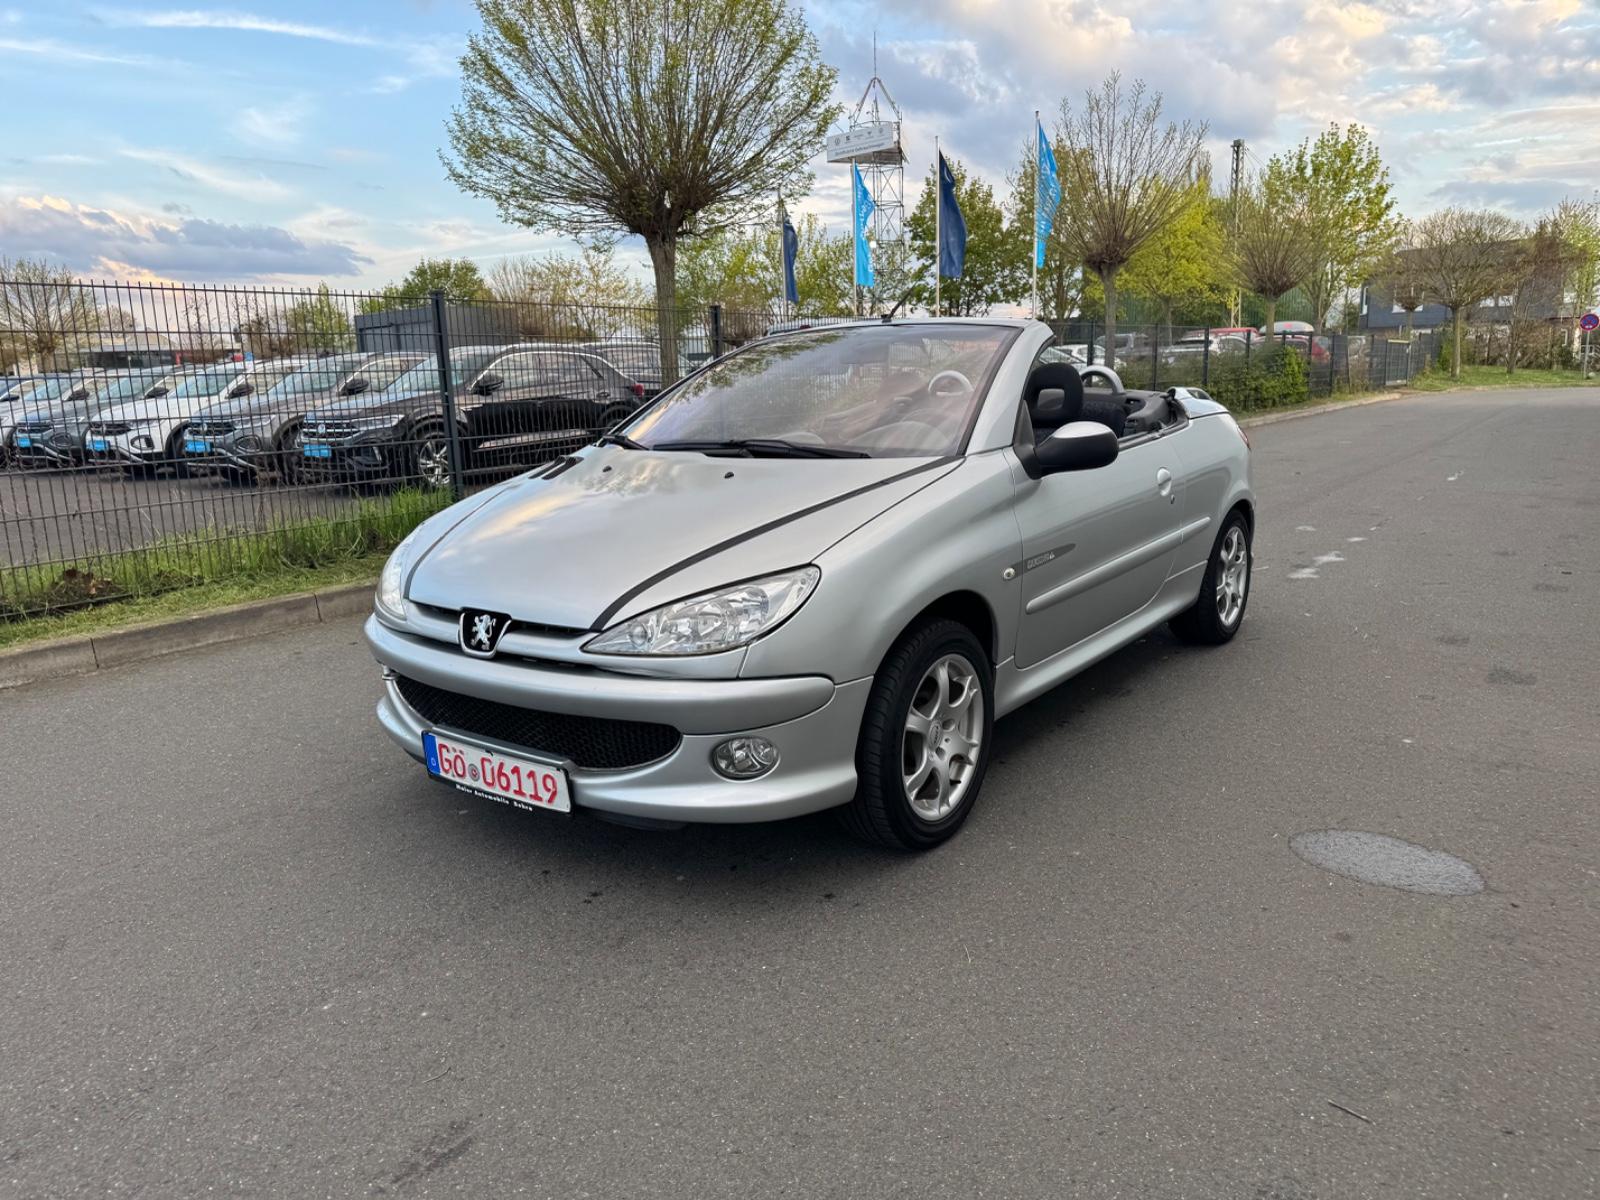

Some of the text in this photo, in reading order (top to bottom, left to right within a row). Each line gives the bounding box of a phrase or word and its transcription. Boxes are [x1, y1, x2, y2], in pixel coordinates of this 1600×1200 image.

[431, 757, 437, 767] D
[438, 743, 558, 804] GÖ 06119
[474, 789, 510, 805] Automobile
